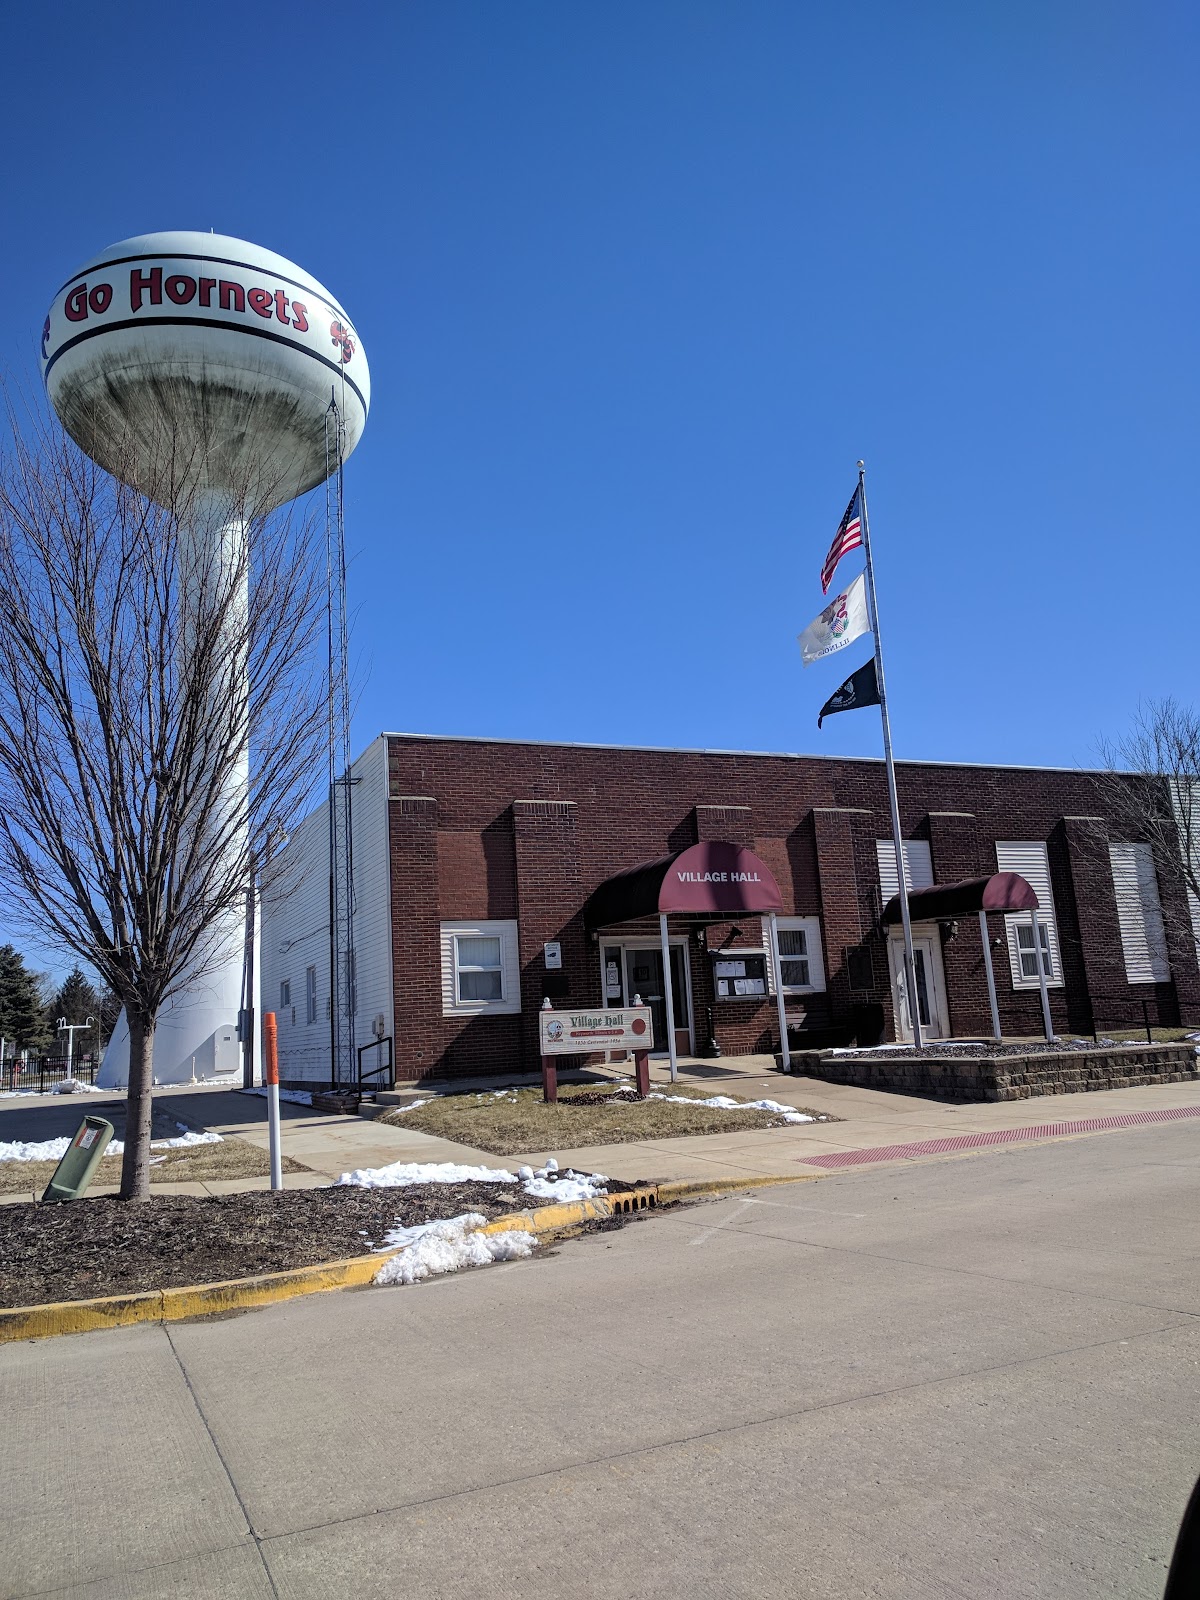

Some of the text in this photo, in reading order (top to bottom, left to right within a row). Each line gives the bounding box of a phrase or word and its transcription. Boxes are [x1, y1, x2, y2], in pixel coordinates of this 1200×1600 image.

[64, 267, 310, 333] Go Hornets
[677, 871, 761, 882] VILLAGE HALL
[569, 1013, 624, 1030] Village Hall
